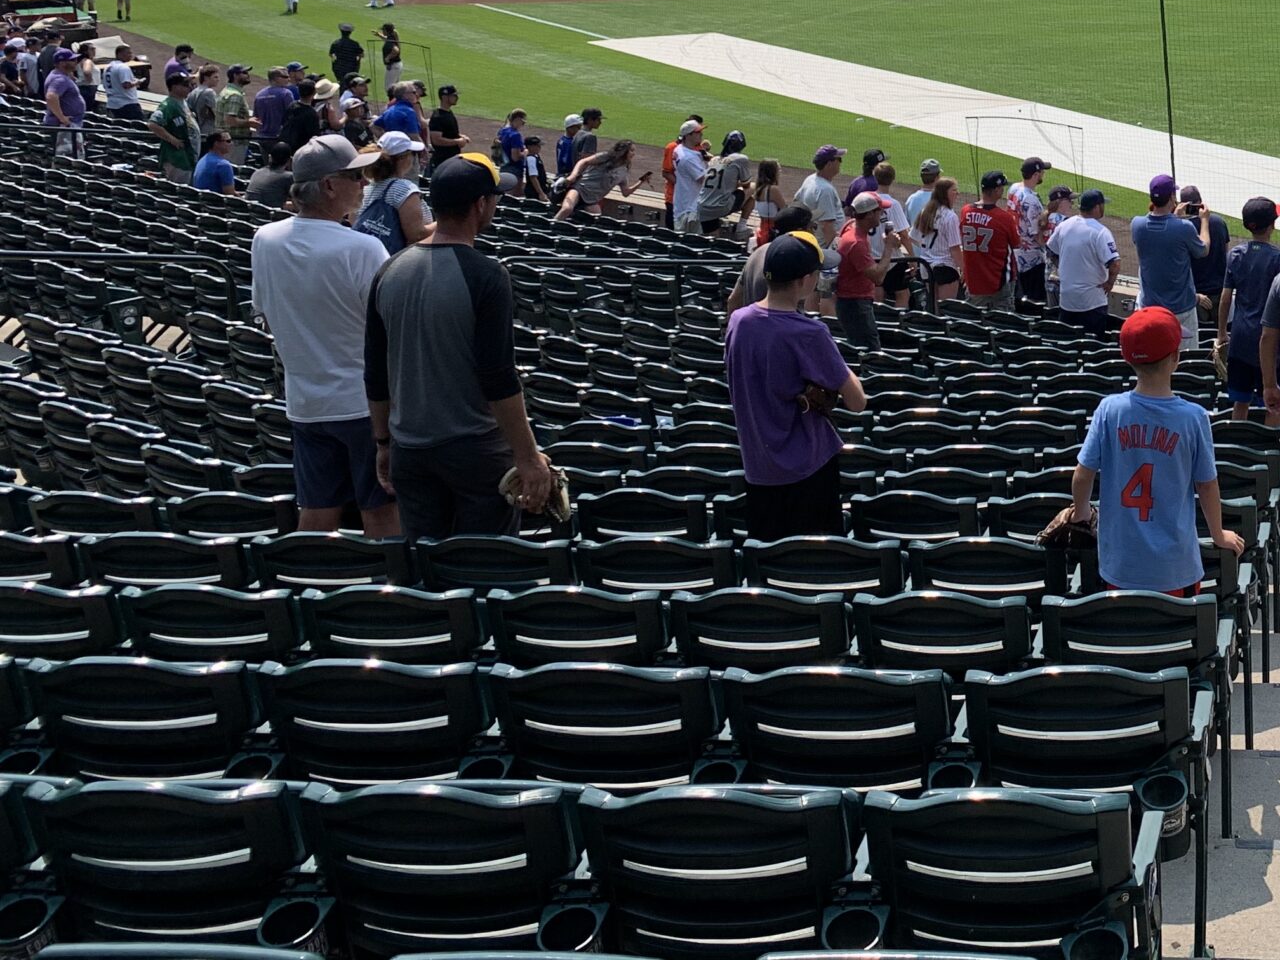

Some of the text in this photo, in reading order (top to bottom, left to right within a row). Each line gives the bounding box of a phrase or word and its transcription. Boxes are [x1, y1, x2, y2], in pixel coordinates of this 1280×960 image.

[704, 168, 725, 190] 21
[965, 212, 993, 226] STORY
[962, 224, 995, 253] 27
[1117, 422, 1180, 457] MOLINA
[1120, 462, 1155, 522] 4
